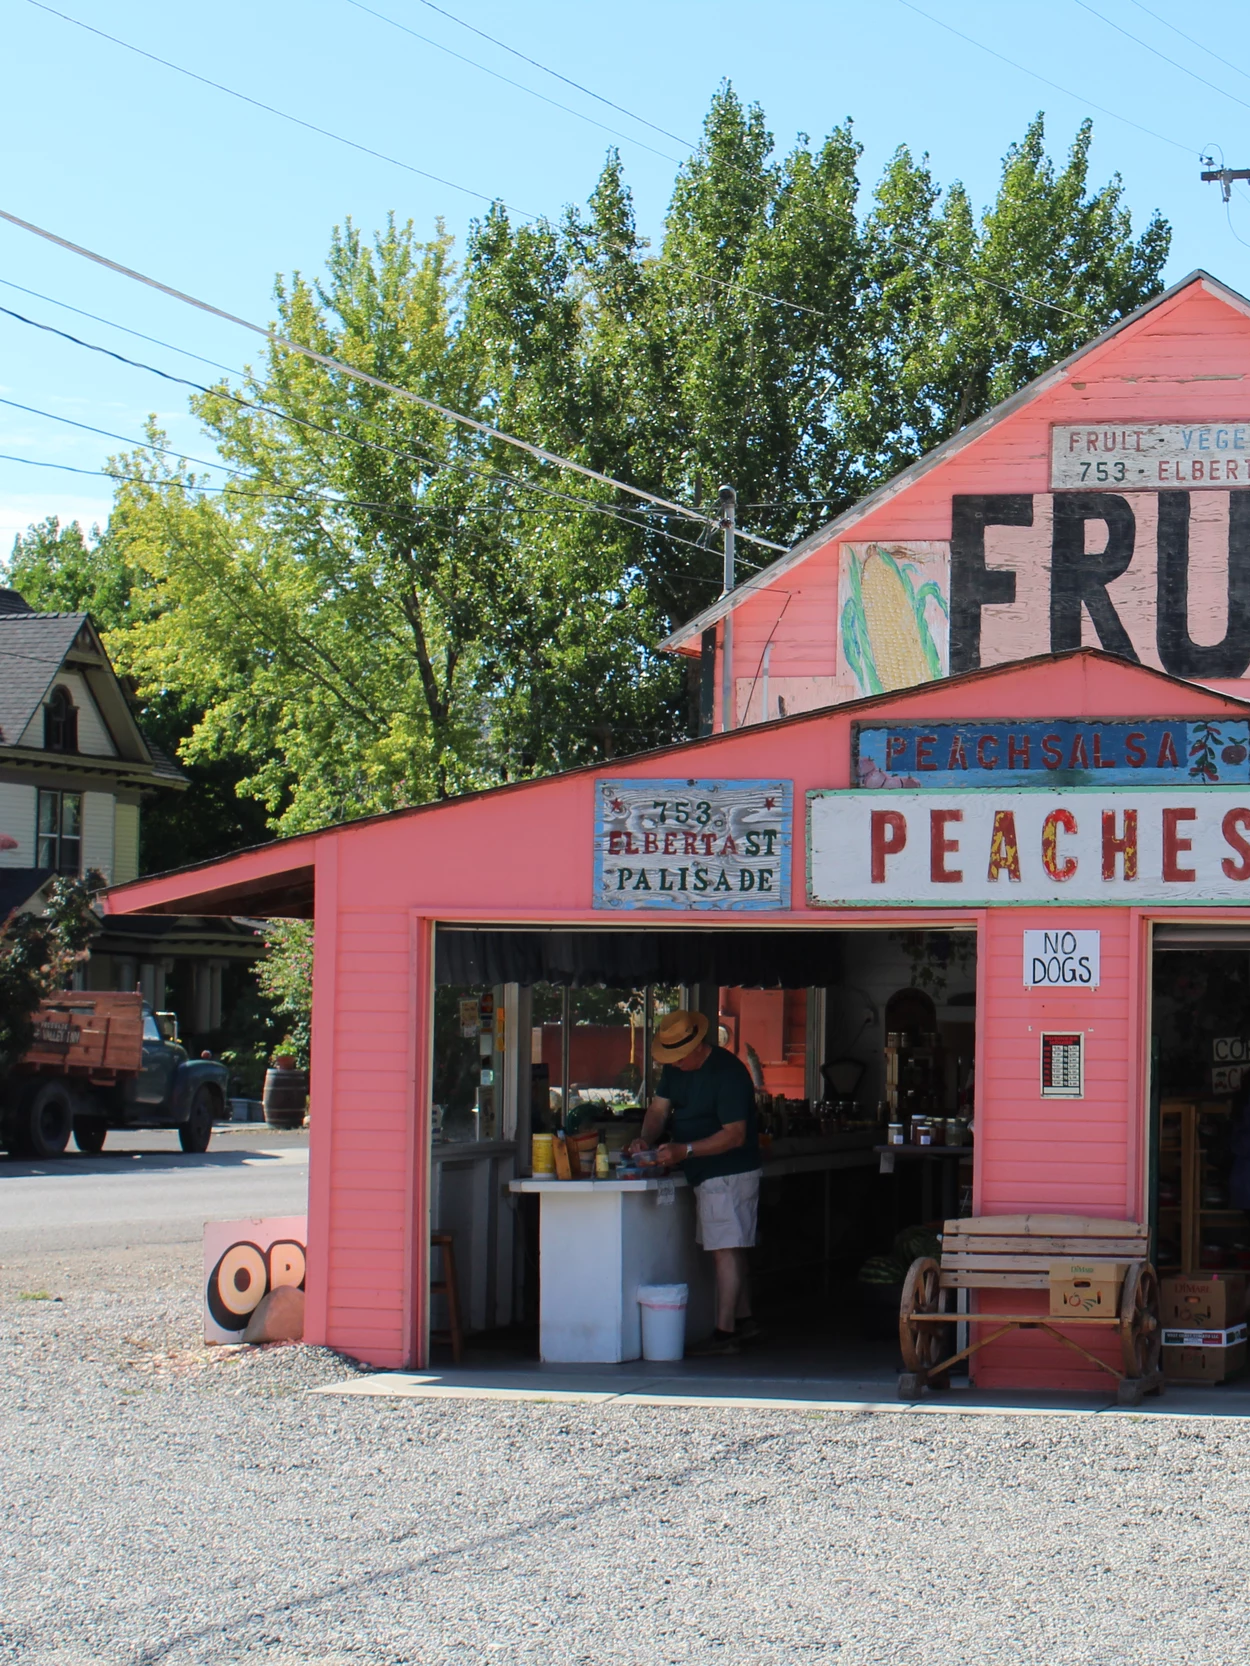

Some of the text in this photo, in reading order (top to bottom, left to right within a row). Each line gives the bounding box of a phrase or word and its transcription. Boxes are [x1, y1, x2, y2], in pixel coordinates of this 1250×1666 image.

[1069, 431, 1144, 452] FRUIT
[1080, 461, 1126, 482] 753
[652, 801, 713, 825] 753
[608, 829, 778, 857] ELBERTA ST
[617, 867, 773, 893] PALISADE
[1044, 931, 1077, 955] NO
[1032, 956, 1092, 984] DOGS
